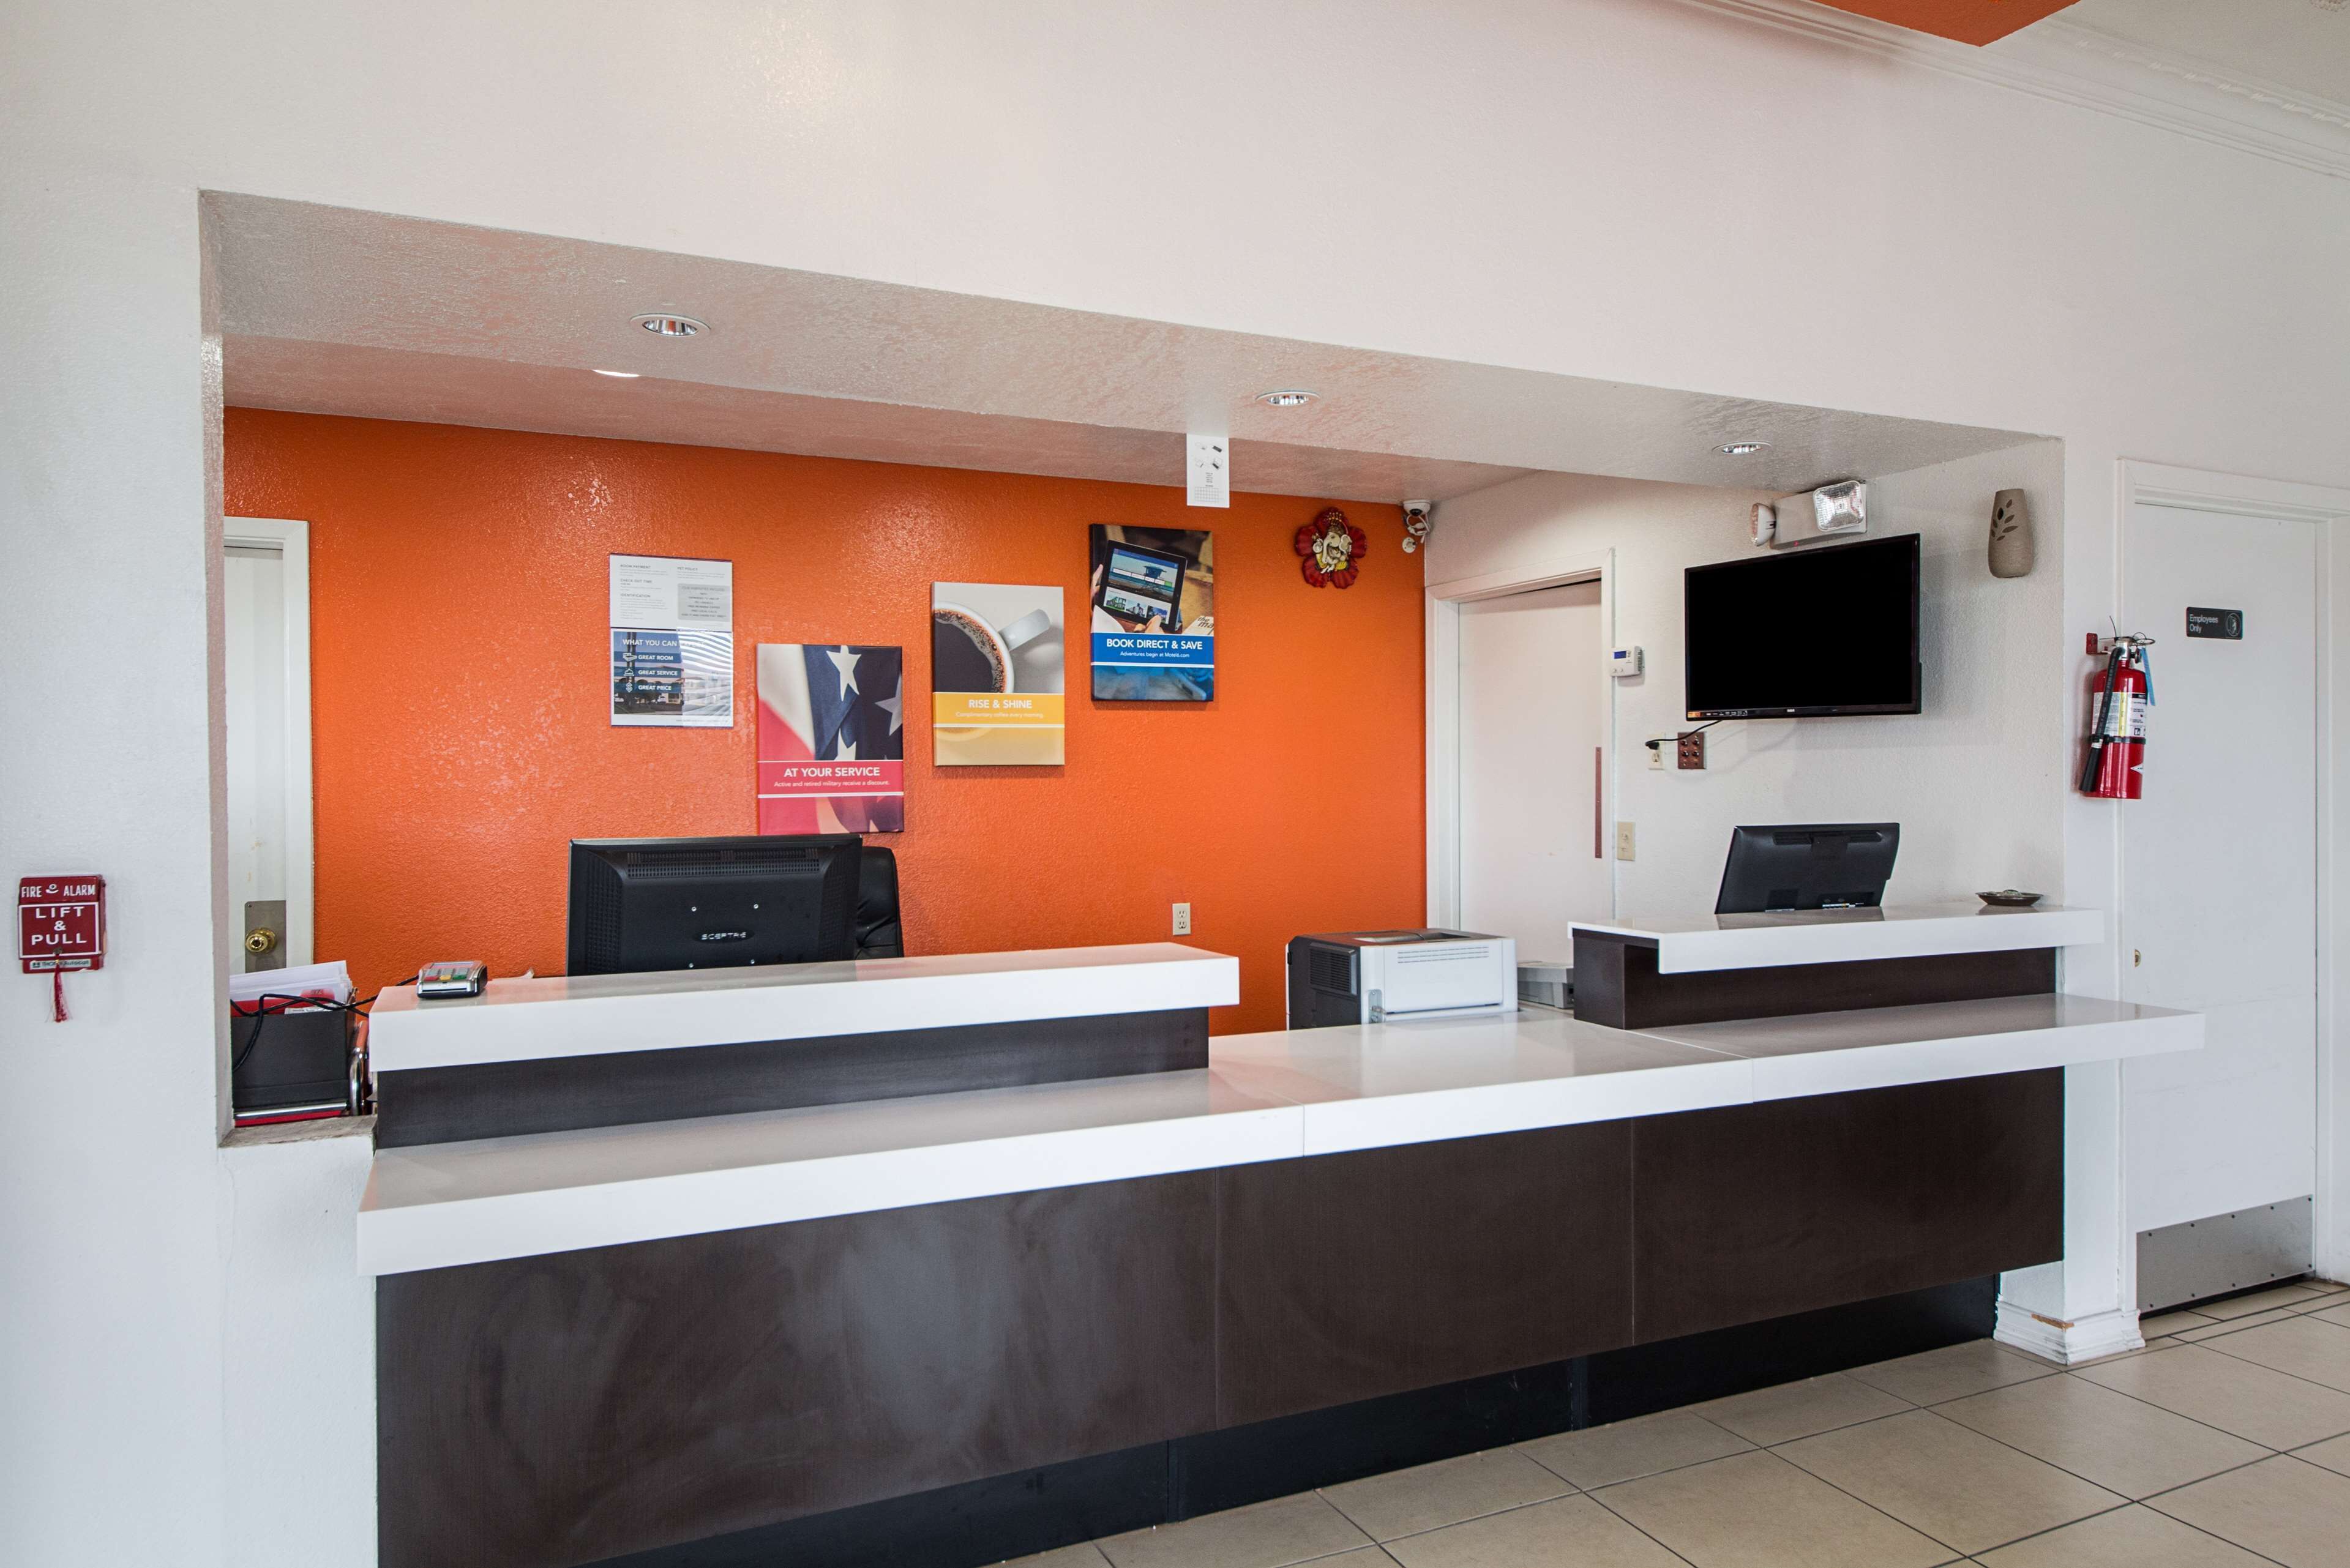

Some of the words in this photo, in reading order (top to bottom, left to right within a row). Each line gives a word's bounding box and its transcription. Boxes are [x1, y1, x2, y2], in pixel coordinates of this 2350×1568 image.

[2189, 614, 2218, 624] Employees
[2189, 624, 2202, 633] Only
[1106, 638, 1134, 648] BOOK
[1137, 640, 1169, 649] DIRECT
[1181, 641, 1203, 649] SAVE
[968, 700, 989, 708] RISE
[1003, 700, 1032, 709] SHINE
[784, 768, 798, 777] AT
[801, 767, 832, 777] YOUR
[835, 767, 880, 777] SERVICE
[21, 886, 42, 898] FIRE
[63, 884, 95, 896] ALARM
[36, 906, 84, 918] LIFT
[54, 920, 67, 931] &
[31, 933, 88, 945] PULL
[702, 931, 746, 940] SCEPTRE
